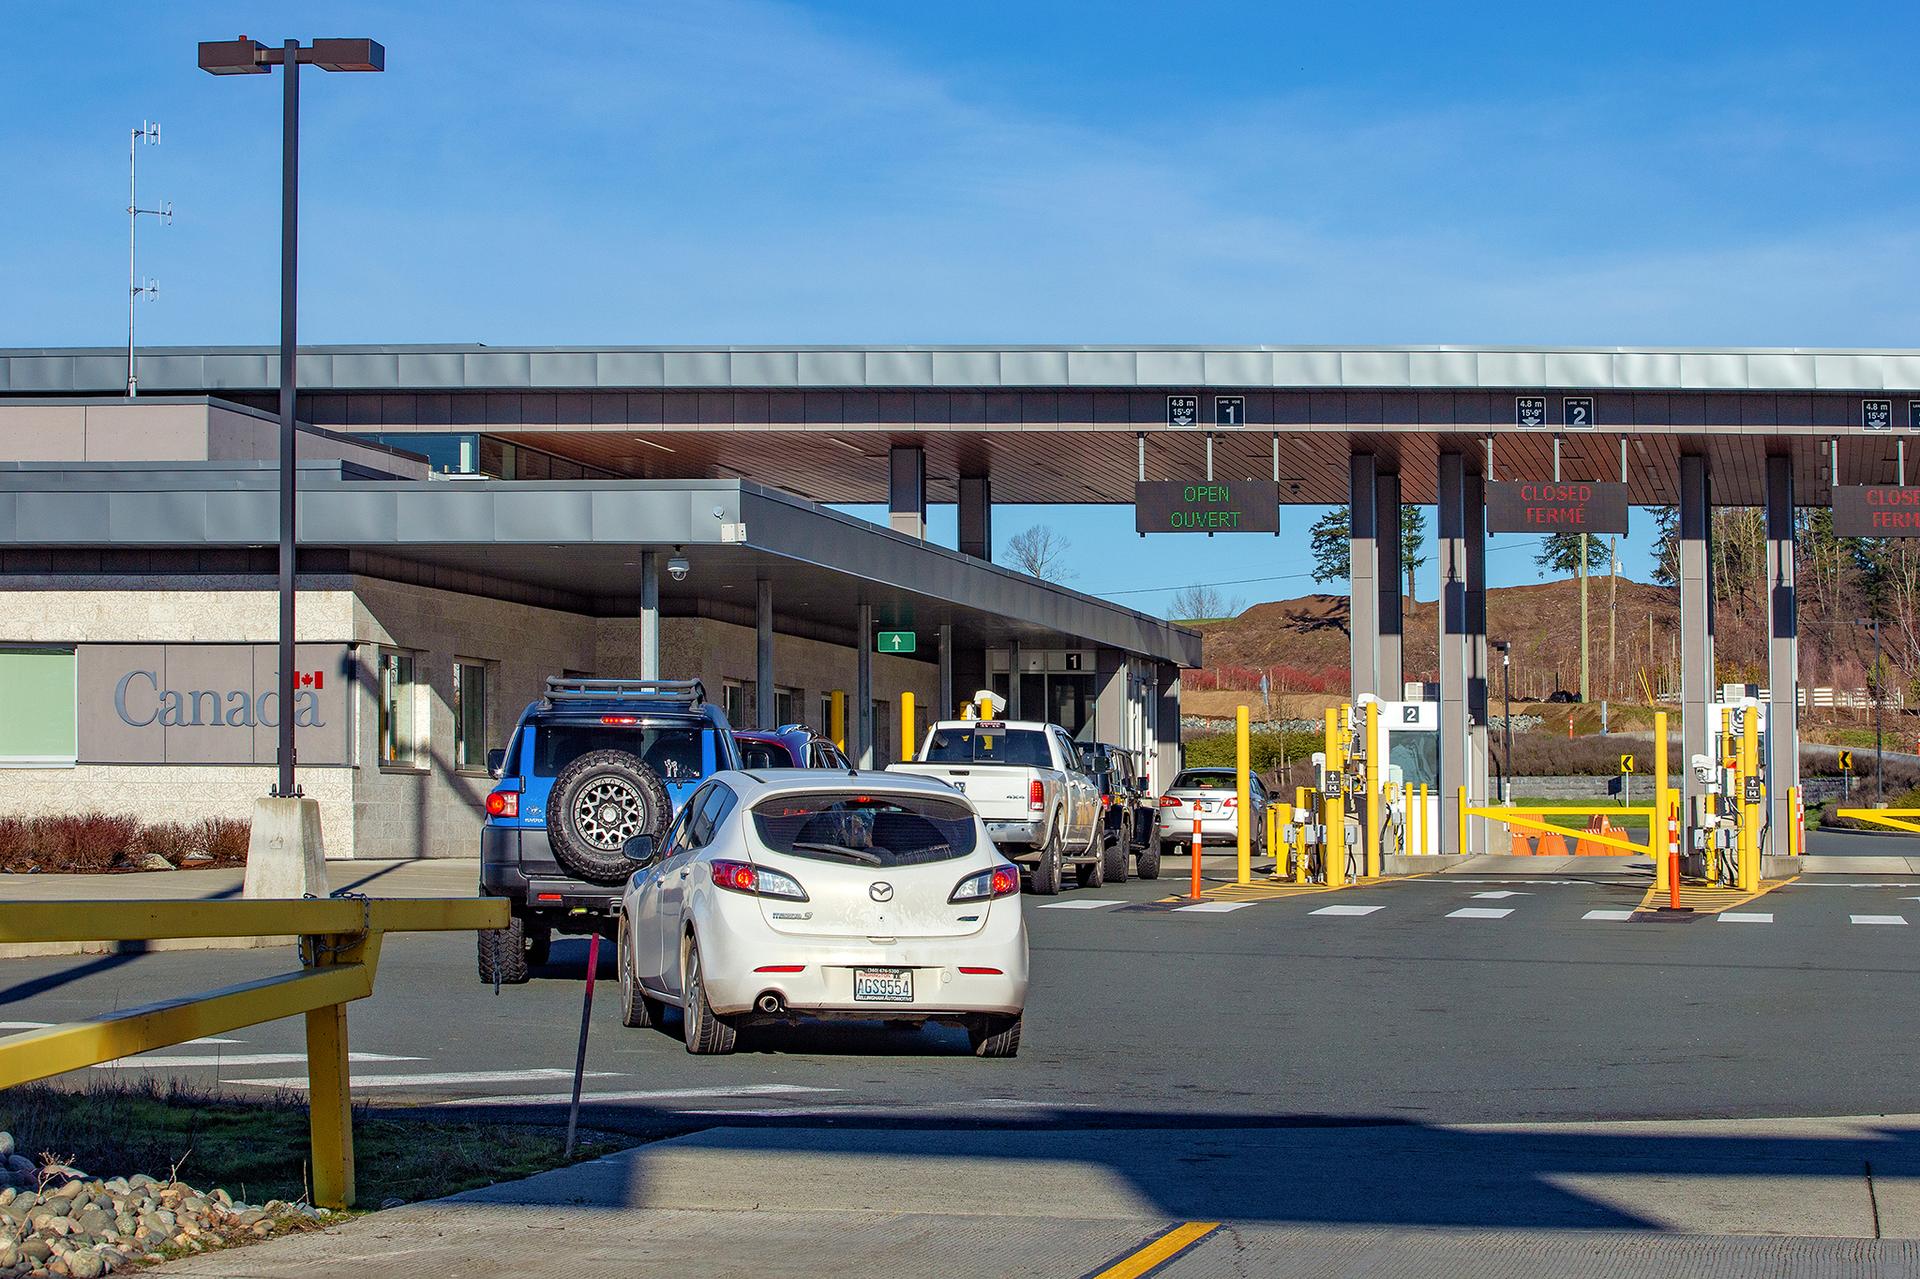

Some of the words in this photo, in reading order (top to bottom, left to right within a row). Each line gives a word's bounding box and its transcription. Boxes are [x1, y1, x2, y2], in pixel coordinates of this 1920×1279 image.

[1171, 399, 1184, 407] 4.8
[1519, 400, 1532, 408] 4.8
[1866, 403, 1878, 411] 4.8
[1172, 408, 1194, 416] 15'-9"
[1225, 405, 1235, 425] 1
[1521, 409, 1542, 417] 15'-9"
[1573, 407, 1586, 425] 2
[1184, 486, 1229, 502] OPEN
[1521, 485, 1592, 501] CLOSED
[1171, 511, 1242, 528] OUVERT
[1526, 502, 1585, 523] FERMÉ
[1070, 655, 1077, 669] 1
[1406, 707, 1417, 721] 2
[857, 978, 909, 995] AGS9554
